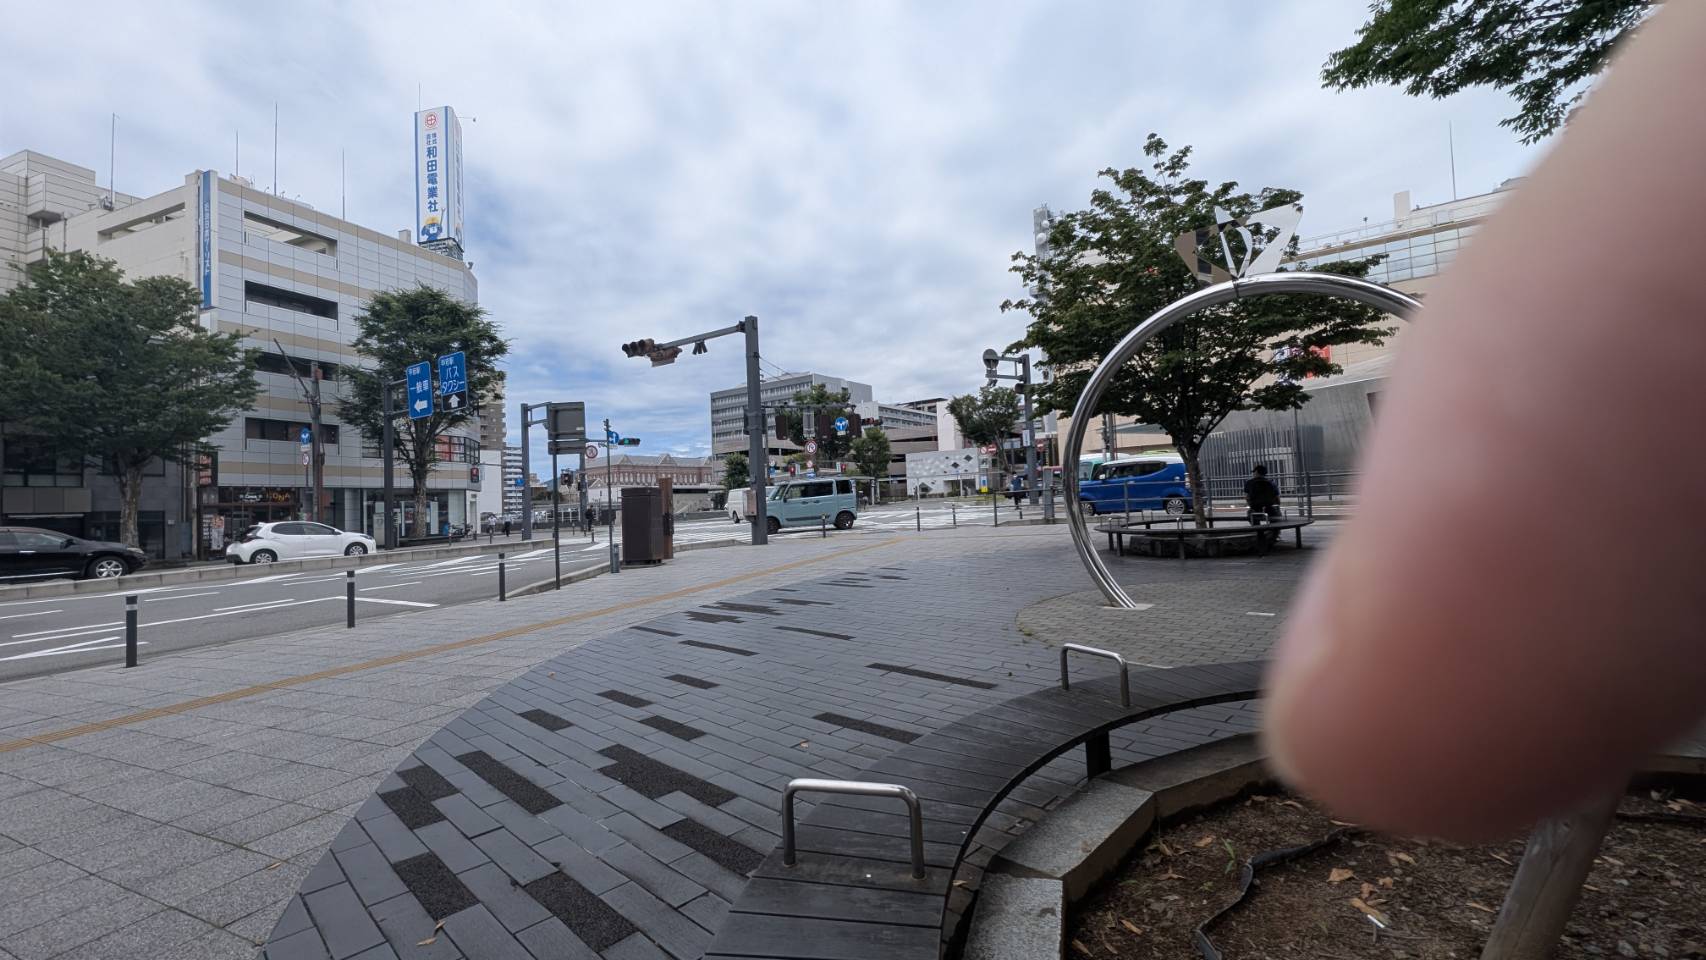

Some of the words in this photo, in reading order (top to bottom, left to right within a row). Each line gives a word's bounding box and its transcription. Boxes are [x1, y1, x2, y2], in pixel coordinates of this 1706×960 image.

[426, 146, 438, 212] 和田電業社
[446, 366, 459, 379] バス
[410, 380, 429, 394] 一般車
[442, 380, 465, 393] タクシー
